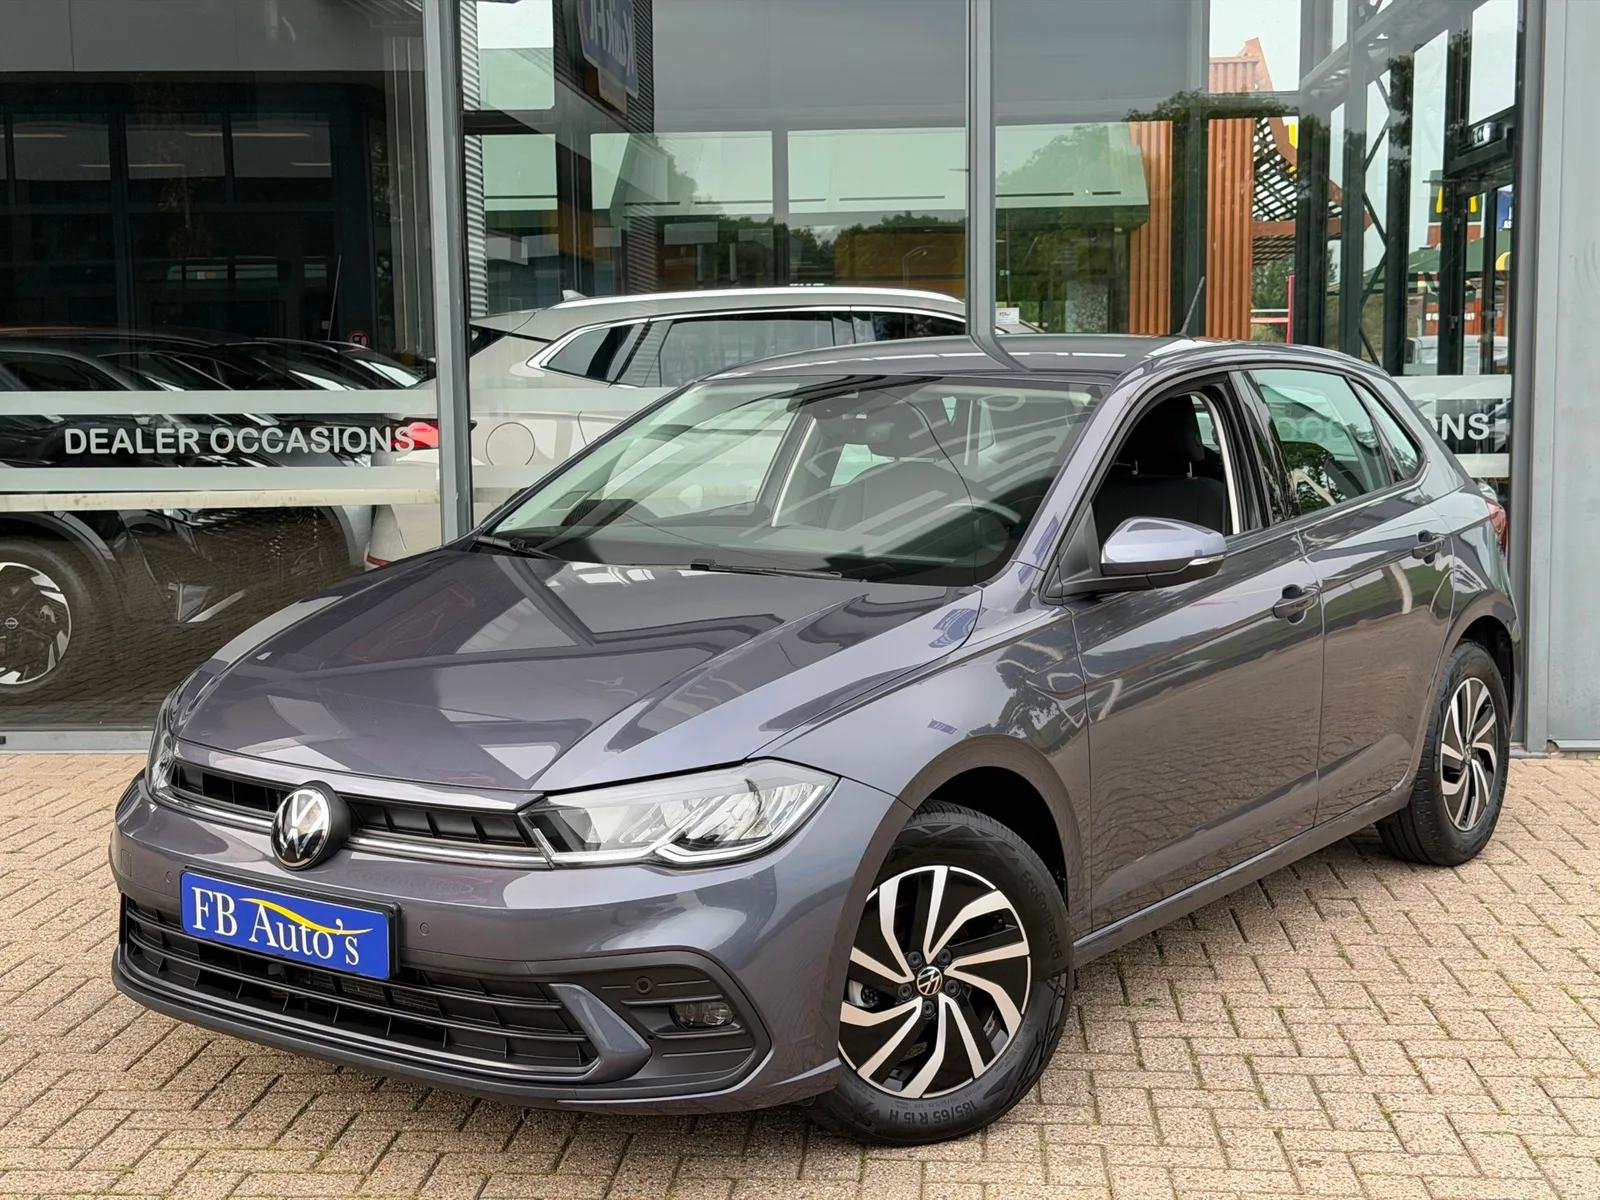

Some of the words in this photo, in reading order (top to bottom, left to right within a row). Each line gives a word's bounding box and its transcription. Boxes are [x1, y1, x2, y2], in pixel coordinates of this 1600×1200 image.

[65, 428, 200, 454] DEALER
[209, 427, 415, 454] OCCASIONS
[192, 887, 238, 937] FB
[249, 903, 359, 966] Auto's
[889, 1109, 899, 1124] H
[904, 1111, 917, 1125] 15
[918, 1111, 928, 1125] R
[932, 1099, 978, 1124] 185/65
